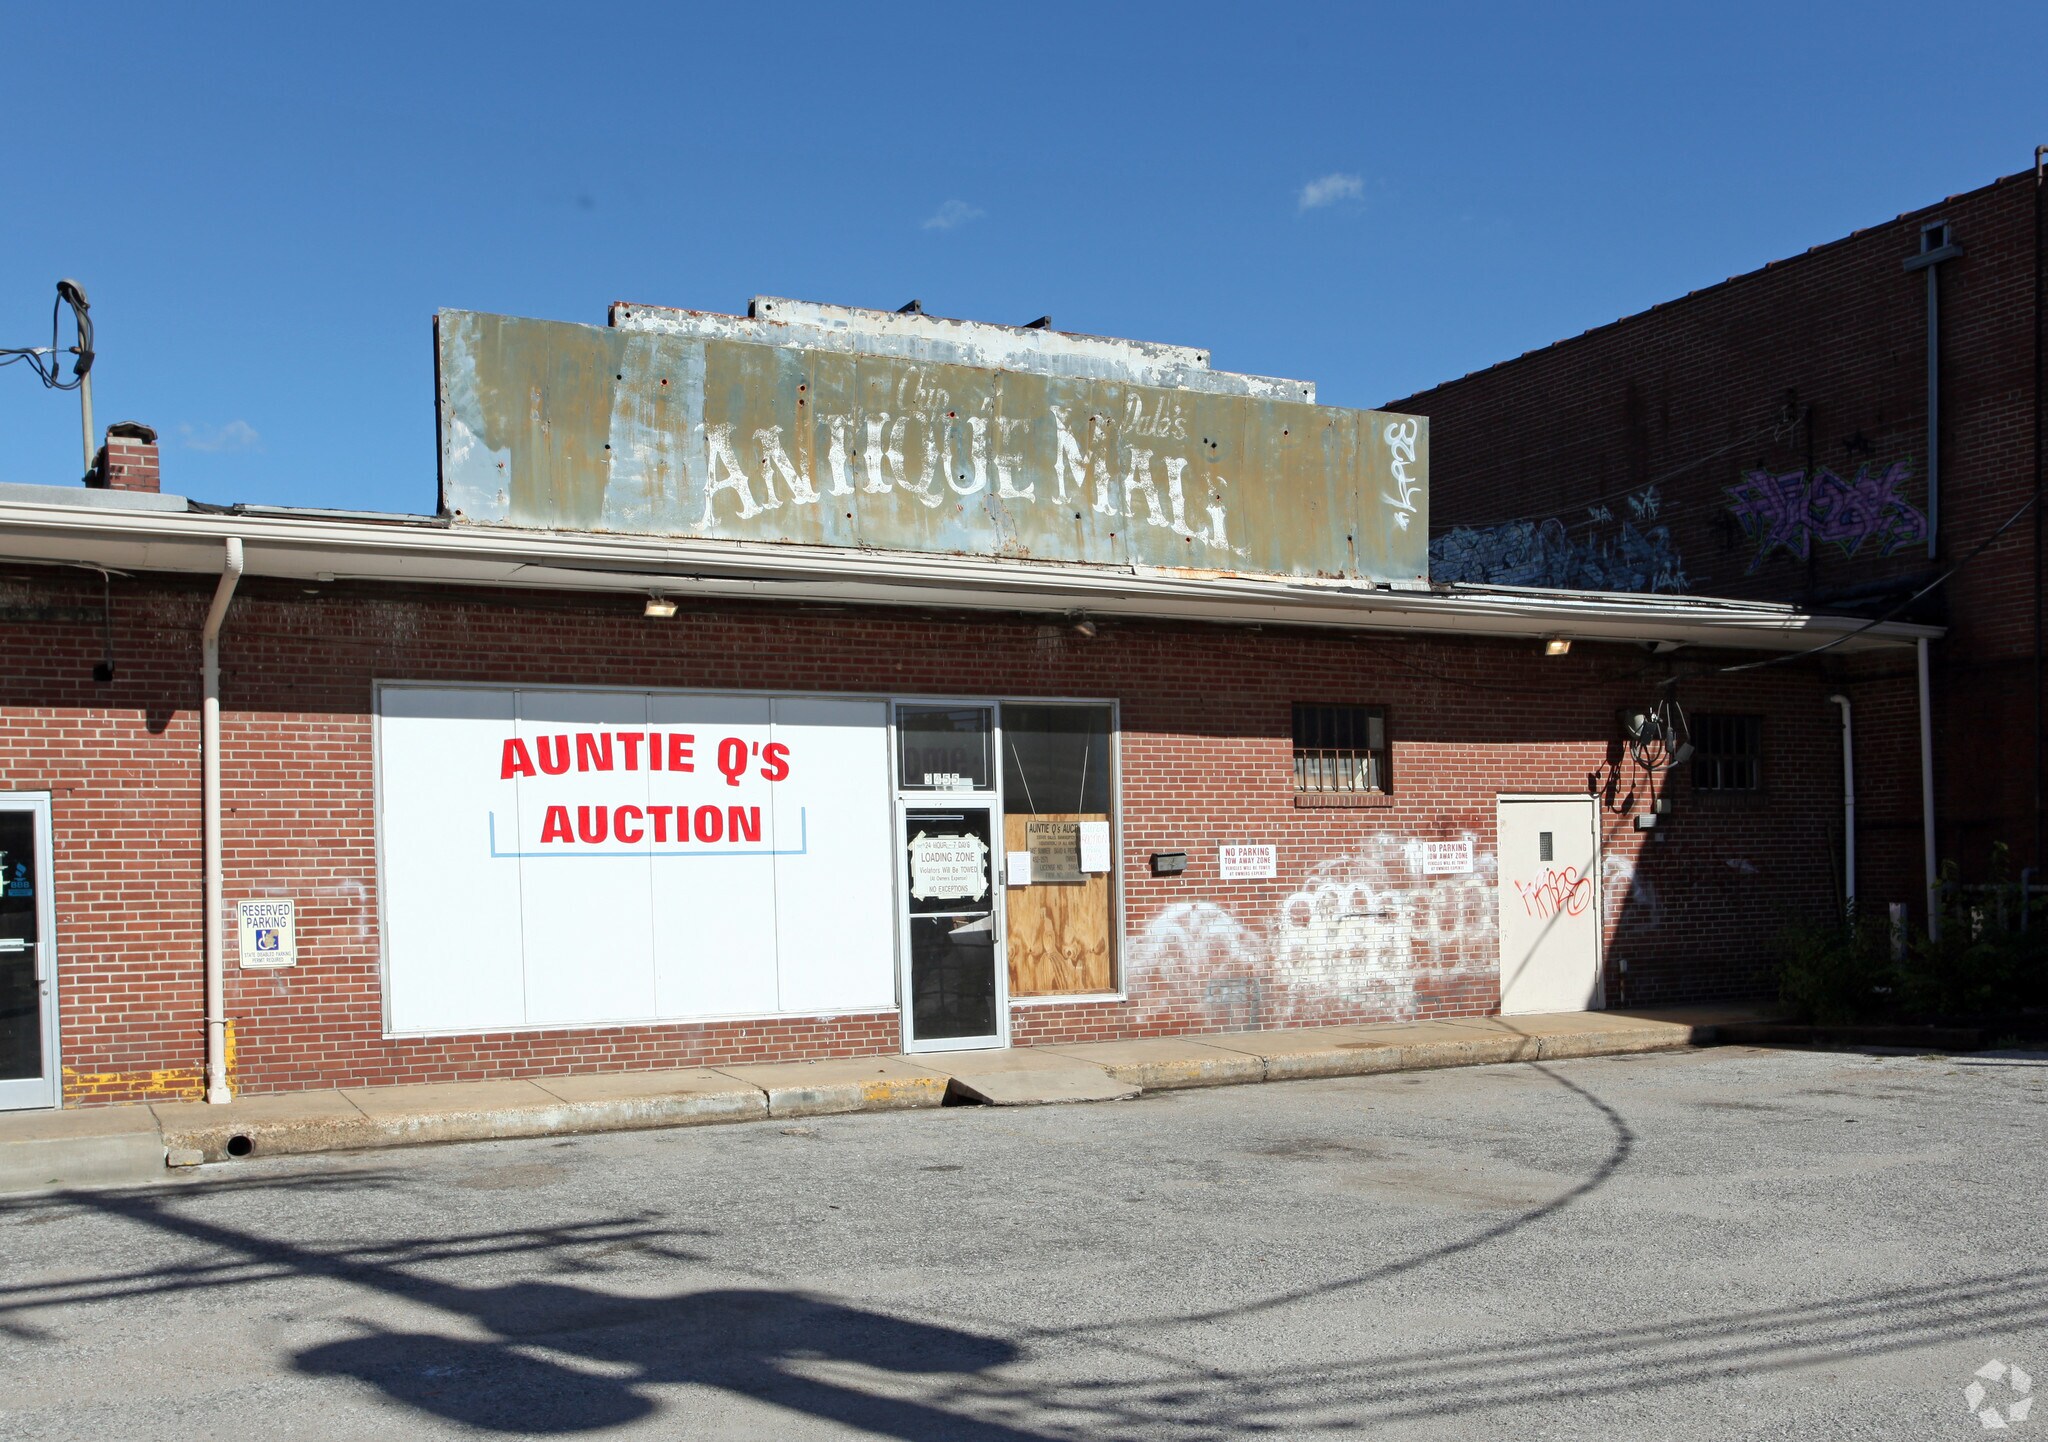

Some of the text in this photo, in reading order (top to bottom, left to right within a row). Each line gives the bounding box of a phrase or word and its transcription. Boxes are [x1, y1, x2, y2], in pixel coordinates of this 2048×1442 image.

[500, 732, 790, 786] AUNTIE Q'S
[924, 773, 960, 785] 3455
[540, 805, 761, 844] AUCTION
[1029, 823, 1049, 834] AUNTIE
[1052, 823, 1060, 835] Q's
[1225, 847, 1270, 857] NO PARKING
[1427, 843, 1467, 852] NO PARKING
[921, 852, 975, 863] LOADING ZONE
[938, 885, 969, 893] EXCEPTIONS
[242, 904, 290, 917] RESERVED
[246, 916, 287, 928] PARKING
